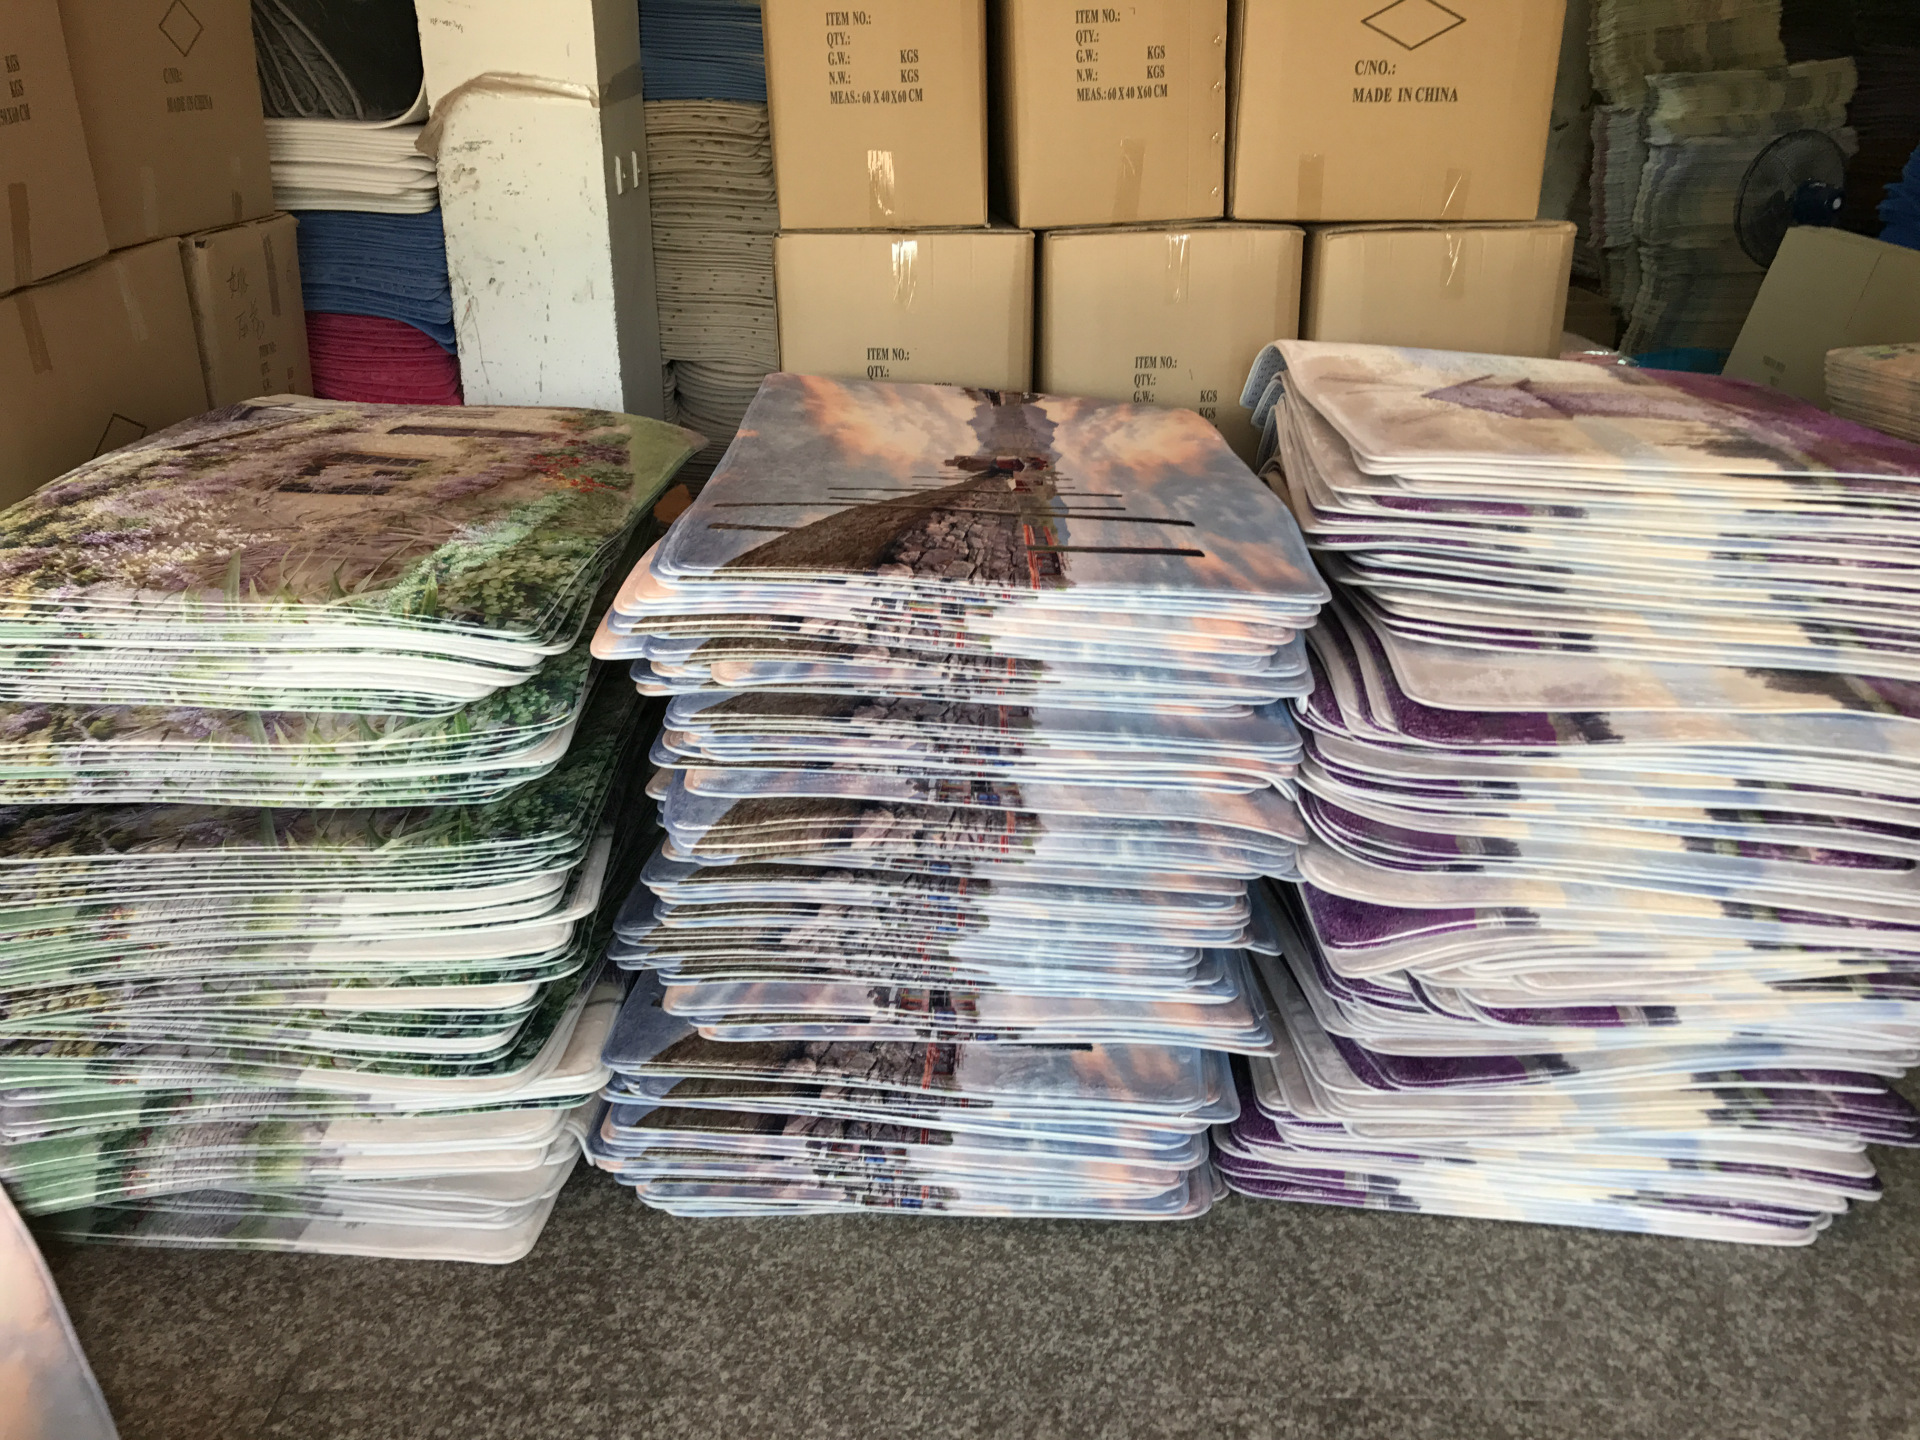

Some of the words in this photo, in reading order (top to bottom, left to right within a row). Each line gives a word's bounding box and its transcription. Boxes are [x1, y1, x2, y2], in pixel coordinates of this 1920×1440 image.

[825, 11, 849, 26] ITEM
[852, 11, 871, 25] NO.:
[1075, 9, 1099, 24] ITEM
[1102, 8, 1120, 23] NO.:
[826, 31, 850, 48] QTY.:
[1075, 29, 1099, 46] QTY.:
[827, 51, 850, 66] G.W.:
[900, 49, 918, 63] KGS
[1075, 48, 1098, 63] G.W.:
[1146, 45, 1165, 60] KGS
[1076, 68, 1098, 82] N.W.:
[1146, 65, 1165, 79] KGS
[1354, 59, 1396, 76] C/NO.:
[828, 71, 851, 85] N.W.:
[900, 69, 919, 83] KGS
[830, 90, 860, 104] MEAS.:
[908, 88, 923, 102] CM
[1076, 86, 1106, 102] MEAS.:
[1153, 83, 1168, 98] CM
[1352, 87, 1392, 103] MADE
[1398, 87, 1413, 102] IN
[1415, 86, 1459, 102] CHINA
[866, 347, 889, 361] ITEM
[892, 347, 910, 361] NO.:
[1134, 356, 1157, 369] ITEM
[1159, 356, 1177, 369] NO.:
[866, 365, 889, 380] QTY.:
[1133, 373, 1156, 388] QTY.:
[1133, 391, 1155, 403] G.W.:
[1200, 389, 1218, 403] KGS
[1198, 407, 1216, 419] KGS
